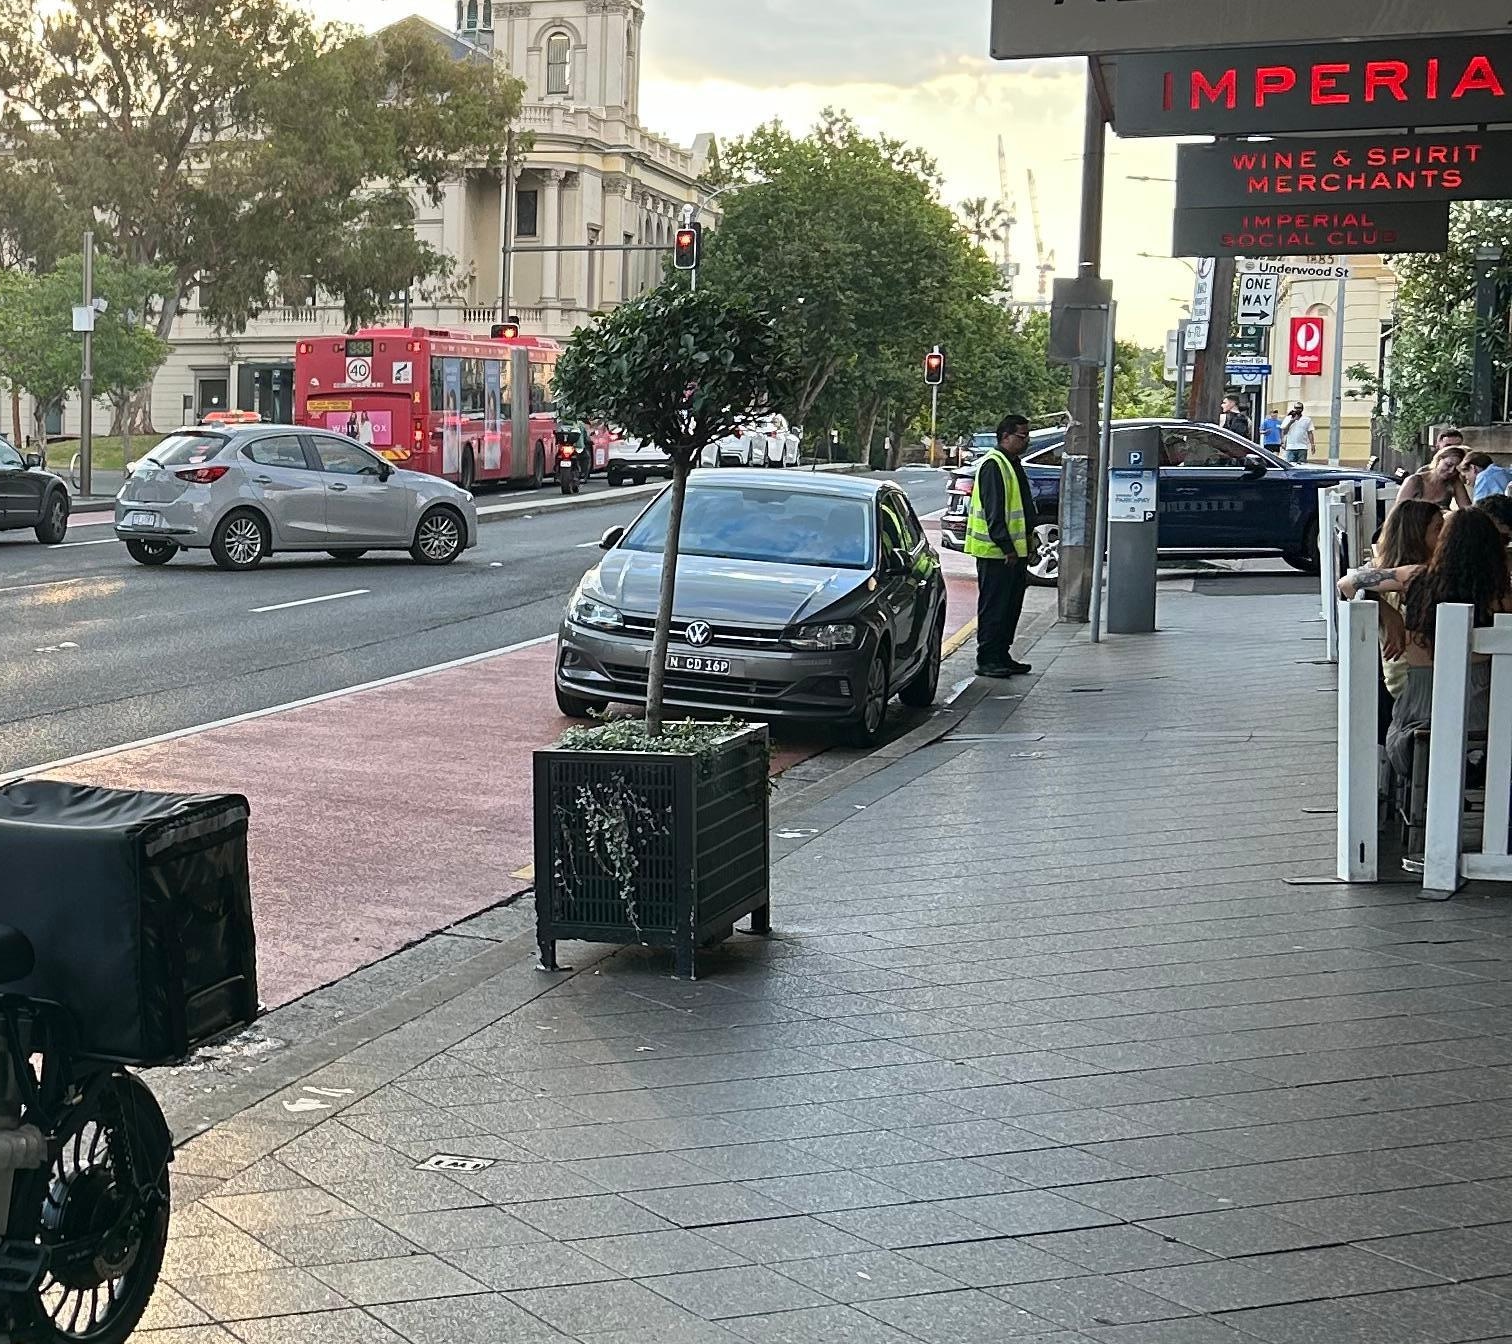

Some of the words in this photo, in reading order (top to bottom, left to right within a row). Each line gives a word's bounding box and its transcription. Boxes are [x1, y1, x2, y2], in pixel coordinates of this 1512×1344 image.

[1231, 152, 1317, 171] WINE
[1332, 150, 1352, 168] &
[1367, 144, 1482, 167] SPIRIT
[1247, 169, 1464, 194] MERCHANTS
[1242, 213, 1375, 230] IMPERIAL
[1220, 232, 1316, 248] SOCIAL
[1326, 229, 1398, 247] CLUB
[1259, 262, 1332, 277] Underwood
[1335, 267, 1350, 278] St
[1245, 278, 1272, 290] ONE
[1242, 295, 1273, 307] WAY
[349, 364, 367, 377] 40
